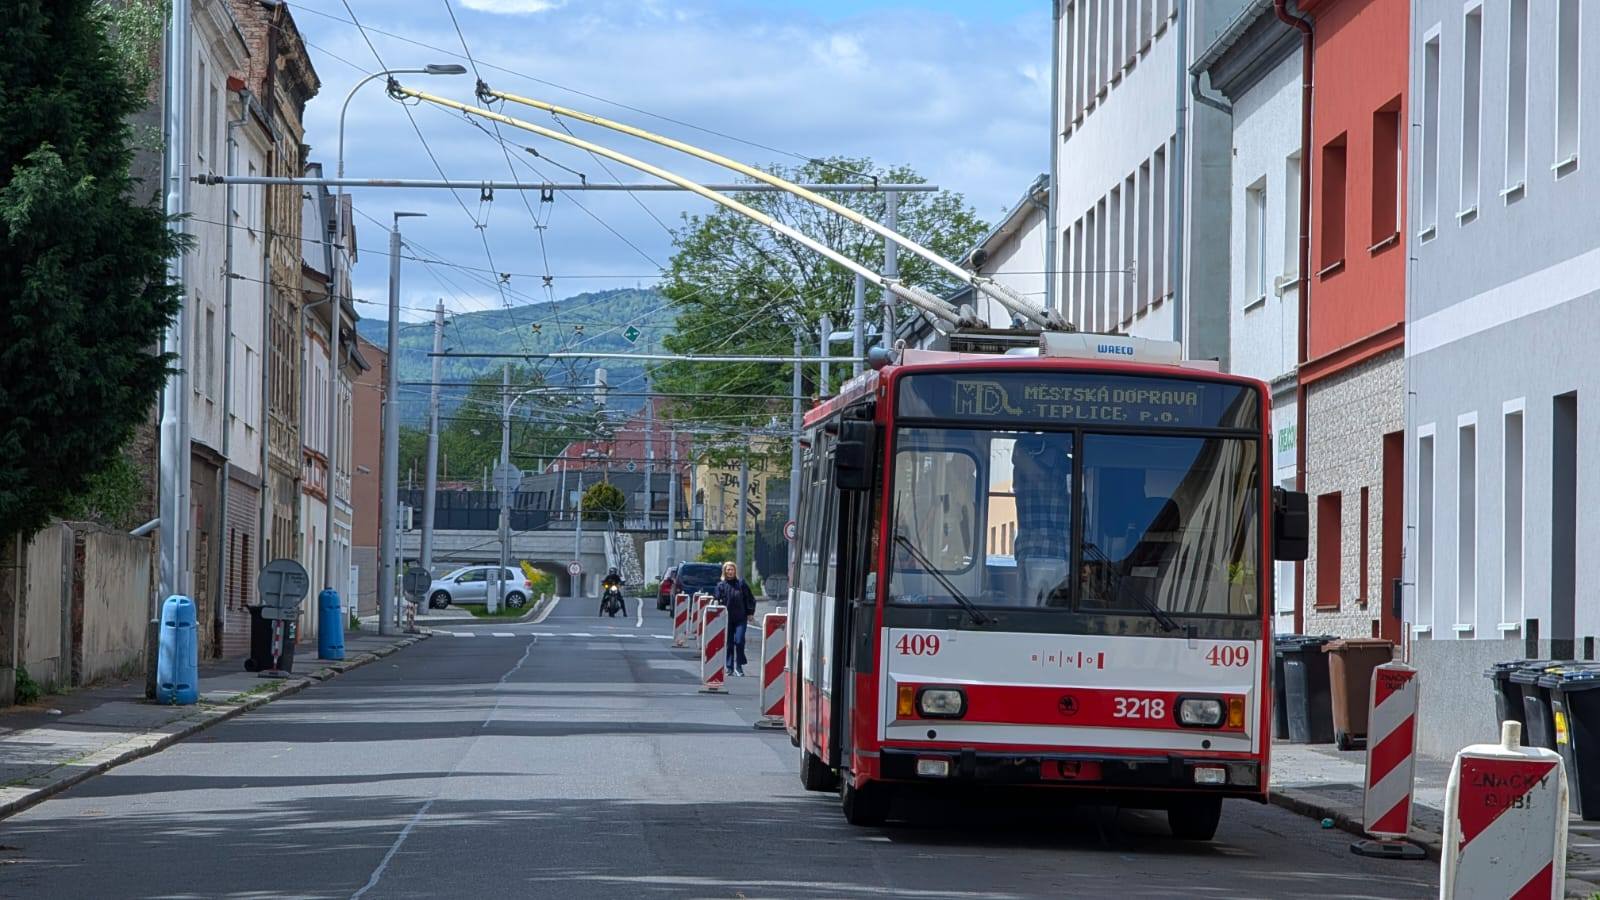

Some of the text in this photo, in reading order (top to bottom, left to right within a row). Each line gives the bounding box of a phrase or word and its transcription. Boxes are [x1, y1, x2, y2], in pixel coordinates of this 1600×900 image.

[1097, 344, 1134, 356] WAECO
[1113, 388, 1197, 406] DOPRAVA
[895, 633, 940, 657] 409
[1206, 645, 1250, 668] 409
[1113, 696, 1165, 719] 3218
